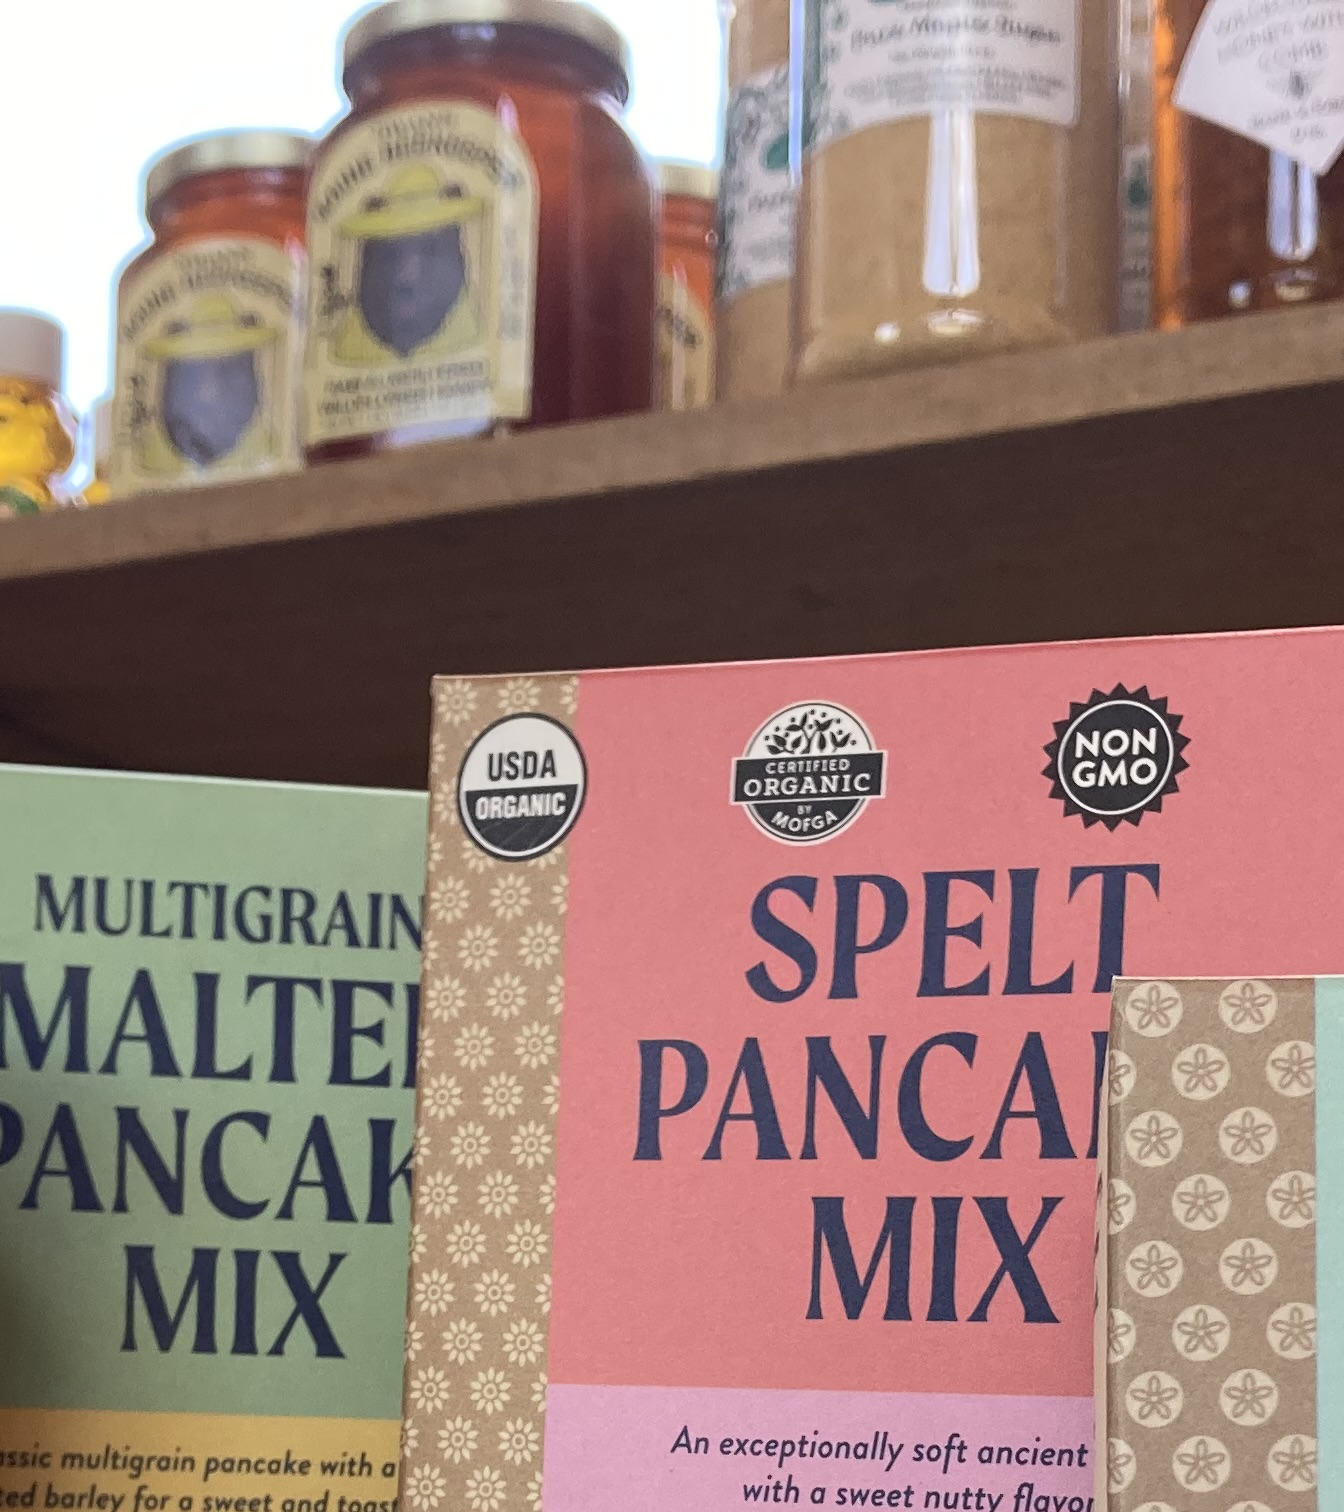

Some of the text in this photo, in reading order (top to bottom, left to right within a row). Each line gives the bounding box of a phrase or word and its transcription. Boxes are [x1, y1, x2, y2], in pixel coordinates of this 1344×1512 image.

[1073, 726, 1158, 760] NON
[486, 749, 558, 783] USDA
[766, 758, 852, 775] CERTIFIED
[1071, 757, 1158, 789] GMO
[742, 771, 872, 798] ORGANIC
[475, 791, 567, 821] ORGANIC
[770, 810, 839, 833] MOFGA
[32, 872, 424, 953] MULTIGRAIN
[745, 862, 1162, 1004] SPELT
[804, 1195, 1066, 1324] MIX
[119, 1243, 350, 1361] MIX
[61, 1443, 197, 1481] multigrain
[202, 1449, 312, 1483] pancake
[319, 1451, 373, 1478] with
[670, 1425, 1090, 1475] An exceptionally soft ancient
[178, 1494, 194, 1512] a
[742, 1474, 800, 1505] with
[809, 1486, 827, 1505] a
[835, 1485, 916, 1509] sweet
